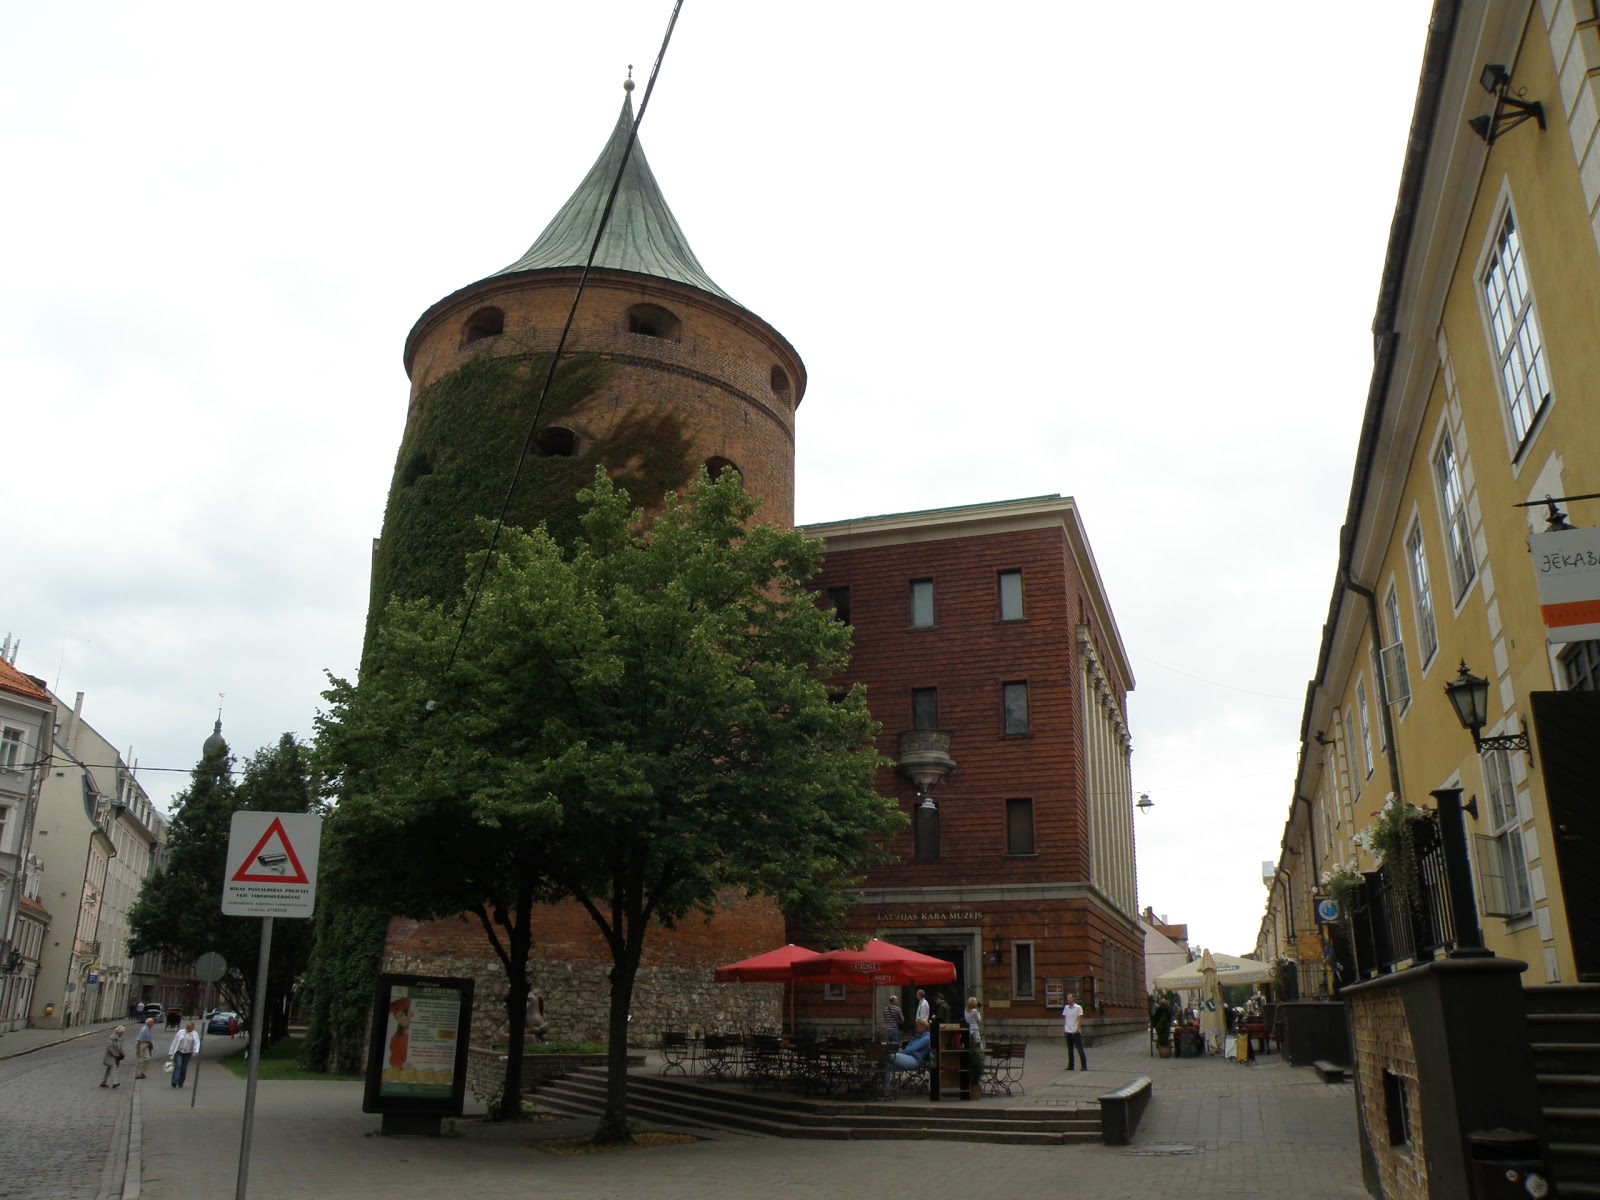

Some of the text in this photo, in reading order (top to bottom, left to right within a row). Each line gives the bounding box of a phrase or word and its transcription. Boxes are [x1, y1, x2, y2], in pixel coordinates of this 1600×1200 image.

[1541, 550, 1600, 573] JĒKAB
[878, 911, 982, 921] LATVIJAS KARA MUZEJS
